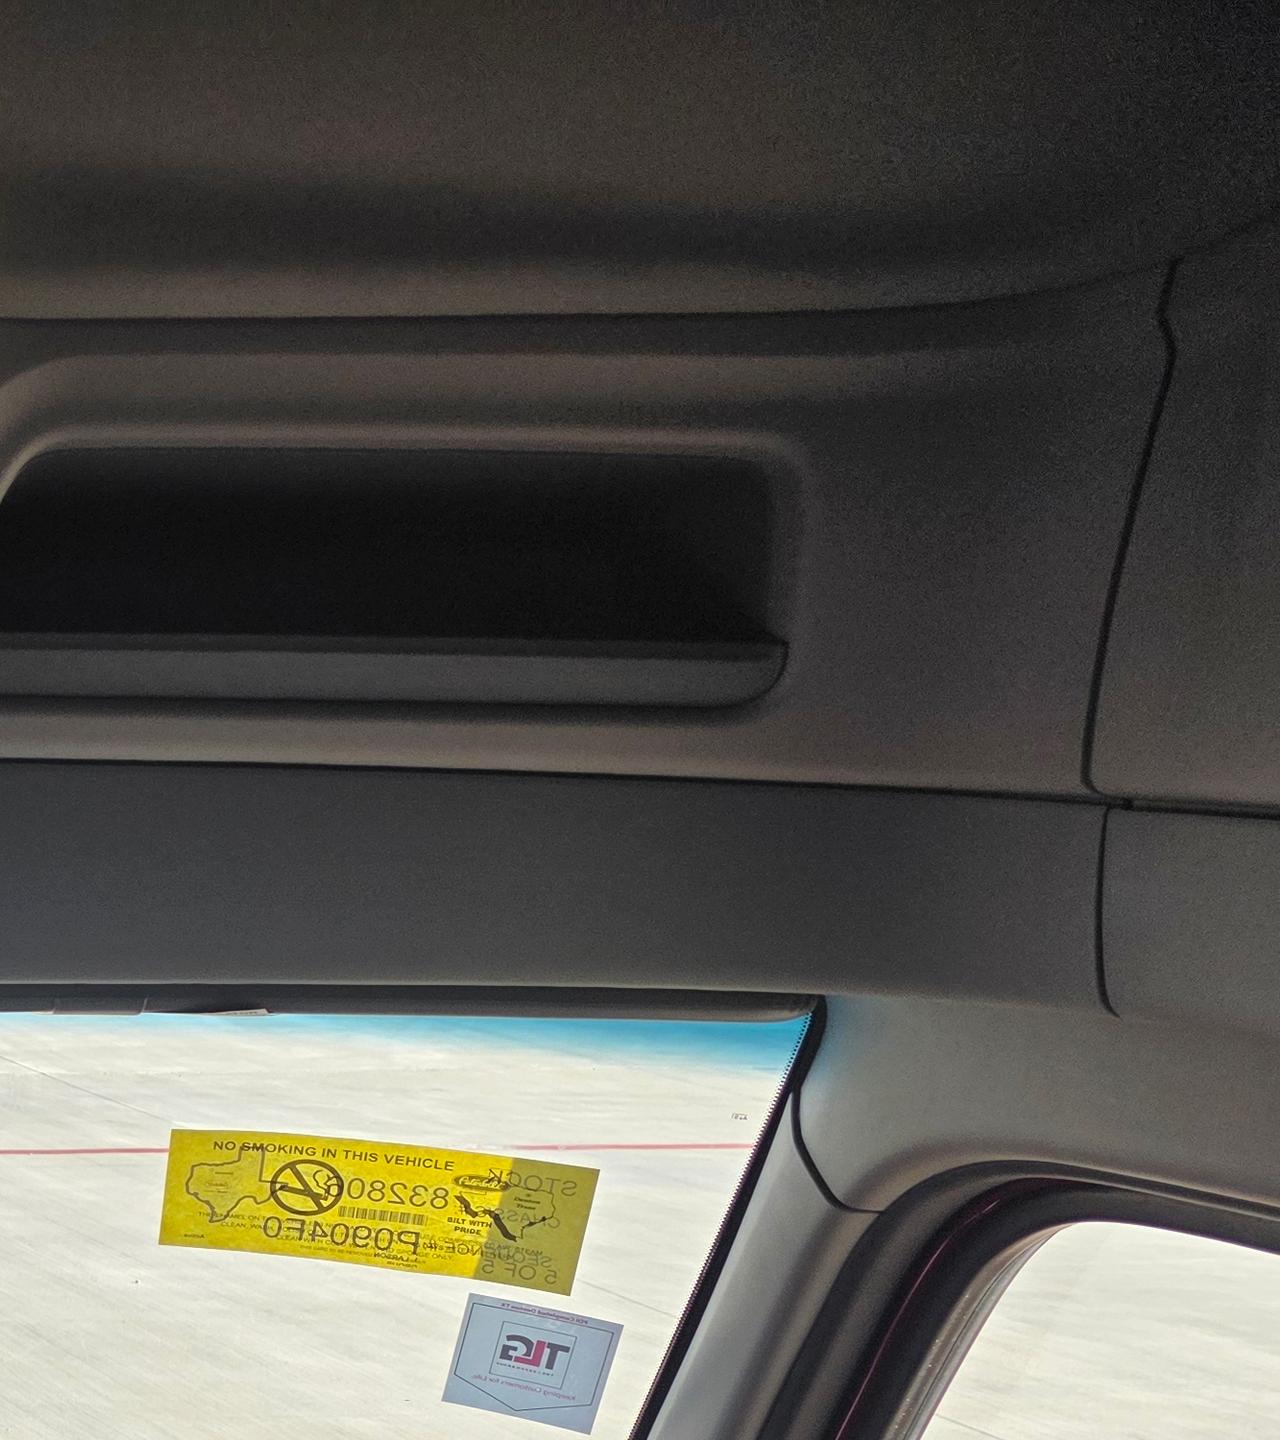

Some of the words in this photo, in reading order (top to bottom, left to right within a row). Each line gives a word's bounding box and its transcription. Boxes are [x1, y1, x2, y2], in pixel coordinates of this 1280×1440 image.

[213, 1140, 236, 1151] NO
[241, 1141, 316, 1156] SMOKING
[321, 1148, 337, 1159] IN
[343, 1149, 379, 1162] THIS
[384, 1154, 455, 1171] VEHICLE
[447, 1216, 467, 1225] BILT
[468, 1218, 492, 1228] WITH
[453, 1225, 482, 1236] PRIDE
